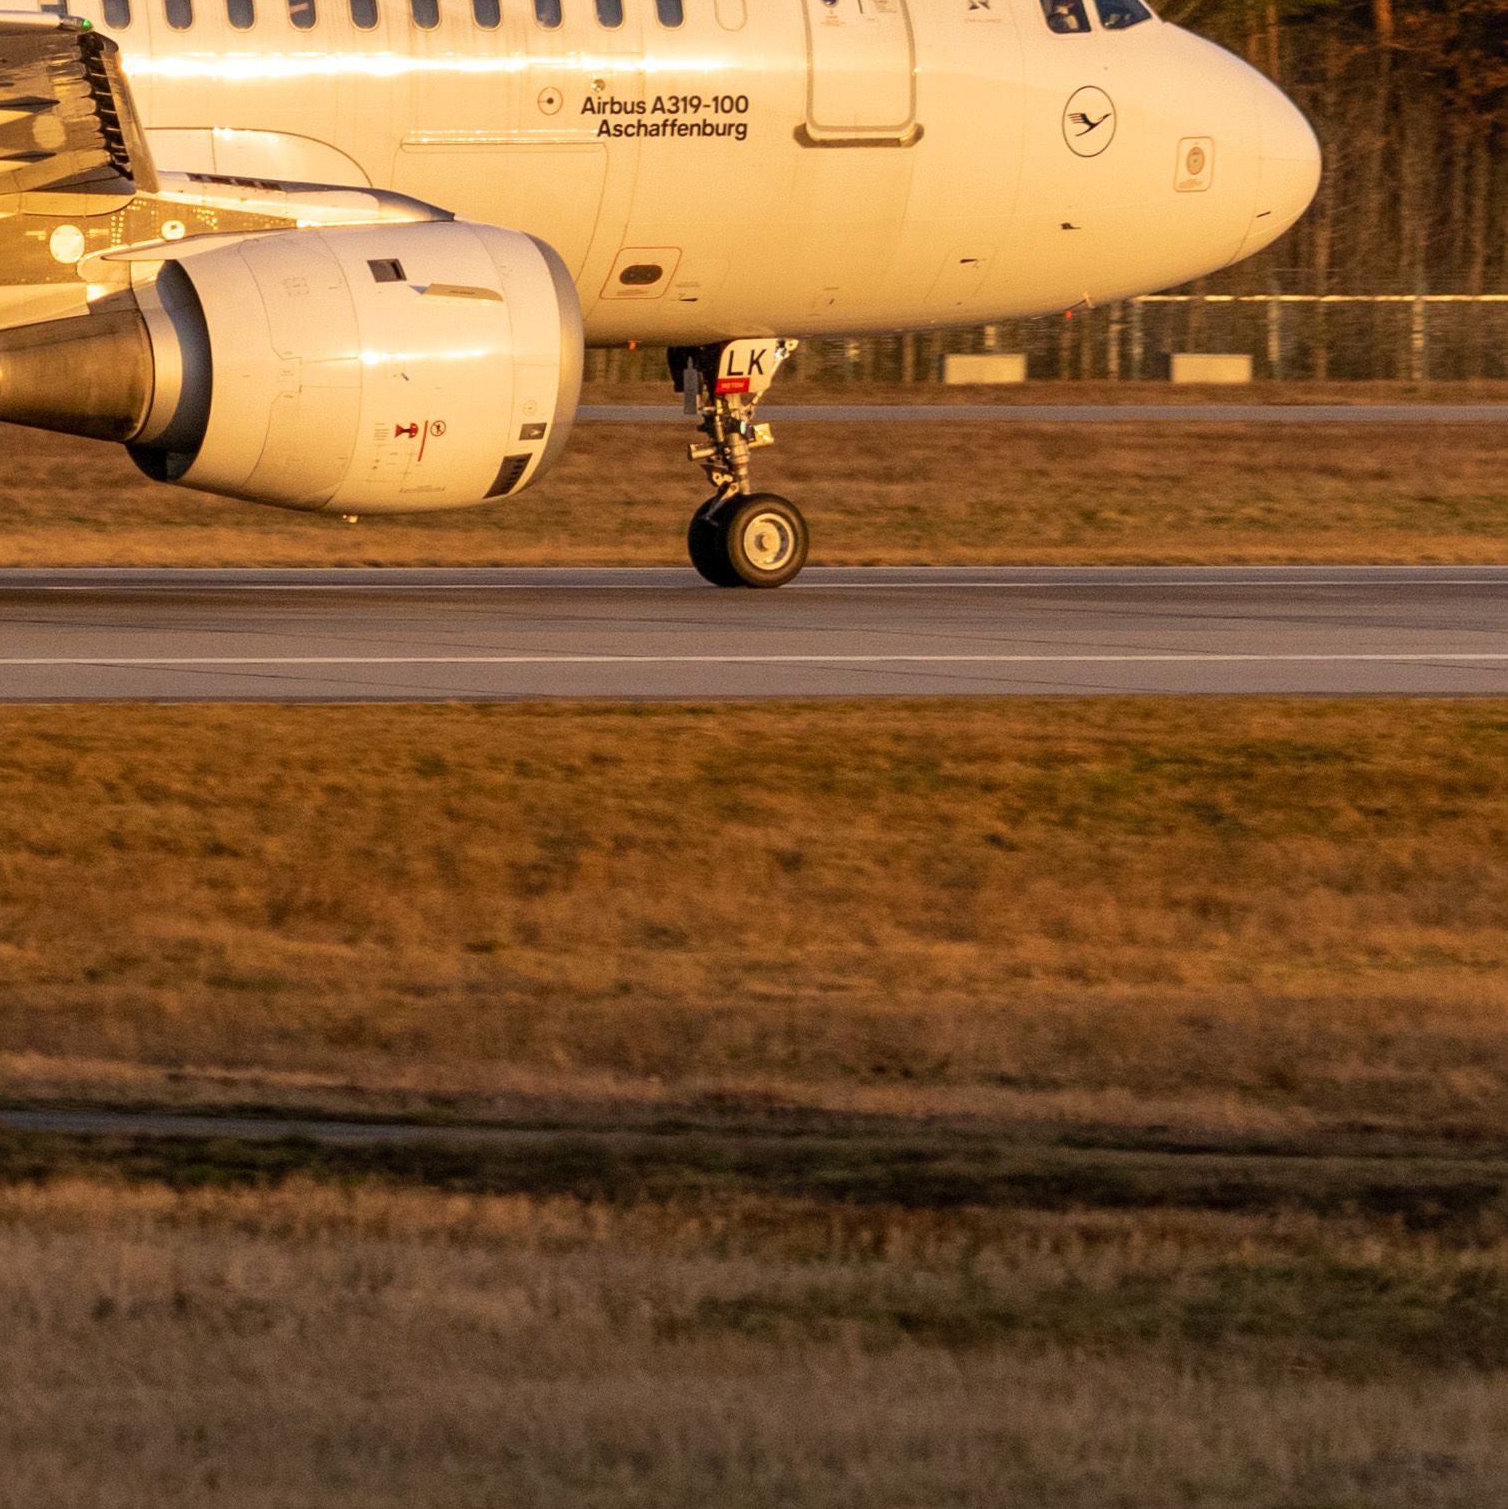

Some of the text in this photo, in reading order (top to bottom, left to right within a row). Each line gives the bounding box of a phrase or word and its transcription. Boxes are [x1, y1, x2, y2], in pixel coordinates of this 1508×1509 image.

[580, 95, 749, 115] Airbus A319-100
[597, 118, 748, 141] Aschaffenburg
[726, 348, 767, 376] LK
